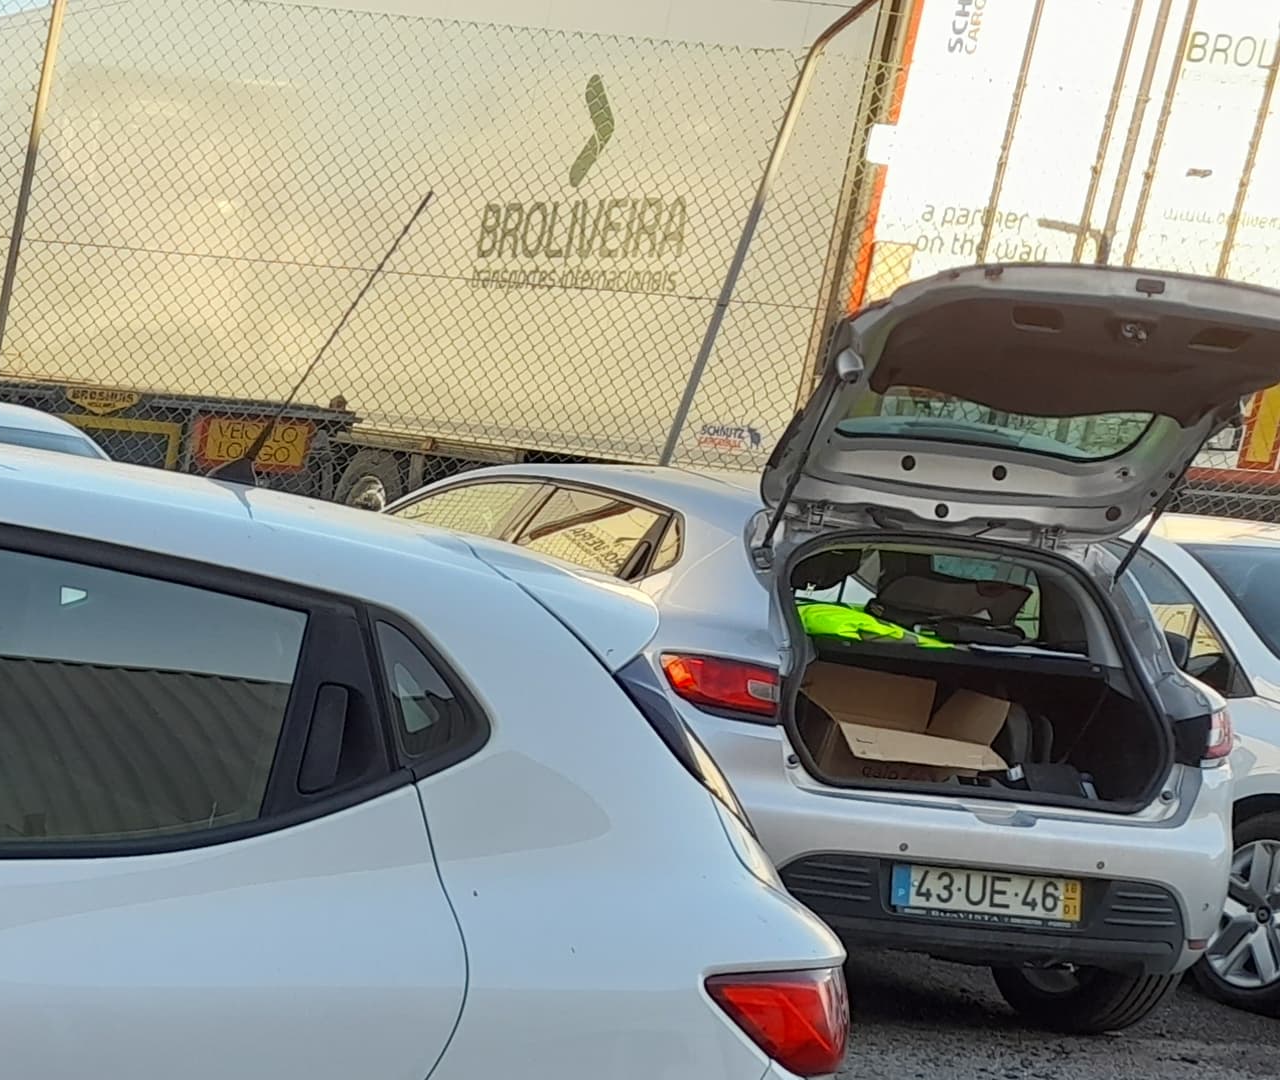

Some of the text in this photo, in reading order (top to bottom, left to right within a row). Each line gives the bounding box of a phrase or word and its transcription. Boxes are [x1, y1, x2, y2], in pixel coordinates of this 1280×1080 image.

[921, 204, 935, 222] a
[476, 197, 687, 258] BROLIVEIRA
[915, 234, 944, 255] on
[218, 422, 298, 444] VEICLO
[1063, 904, 1077, 916] 01
